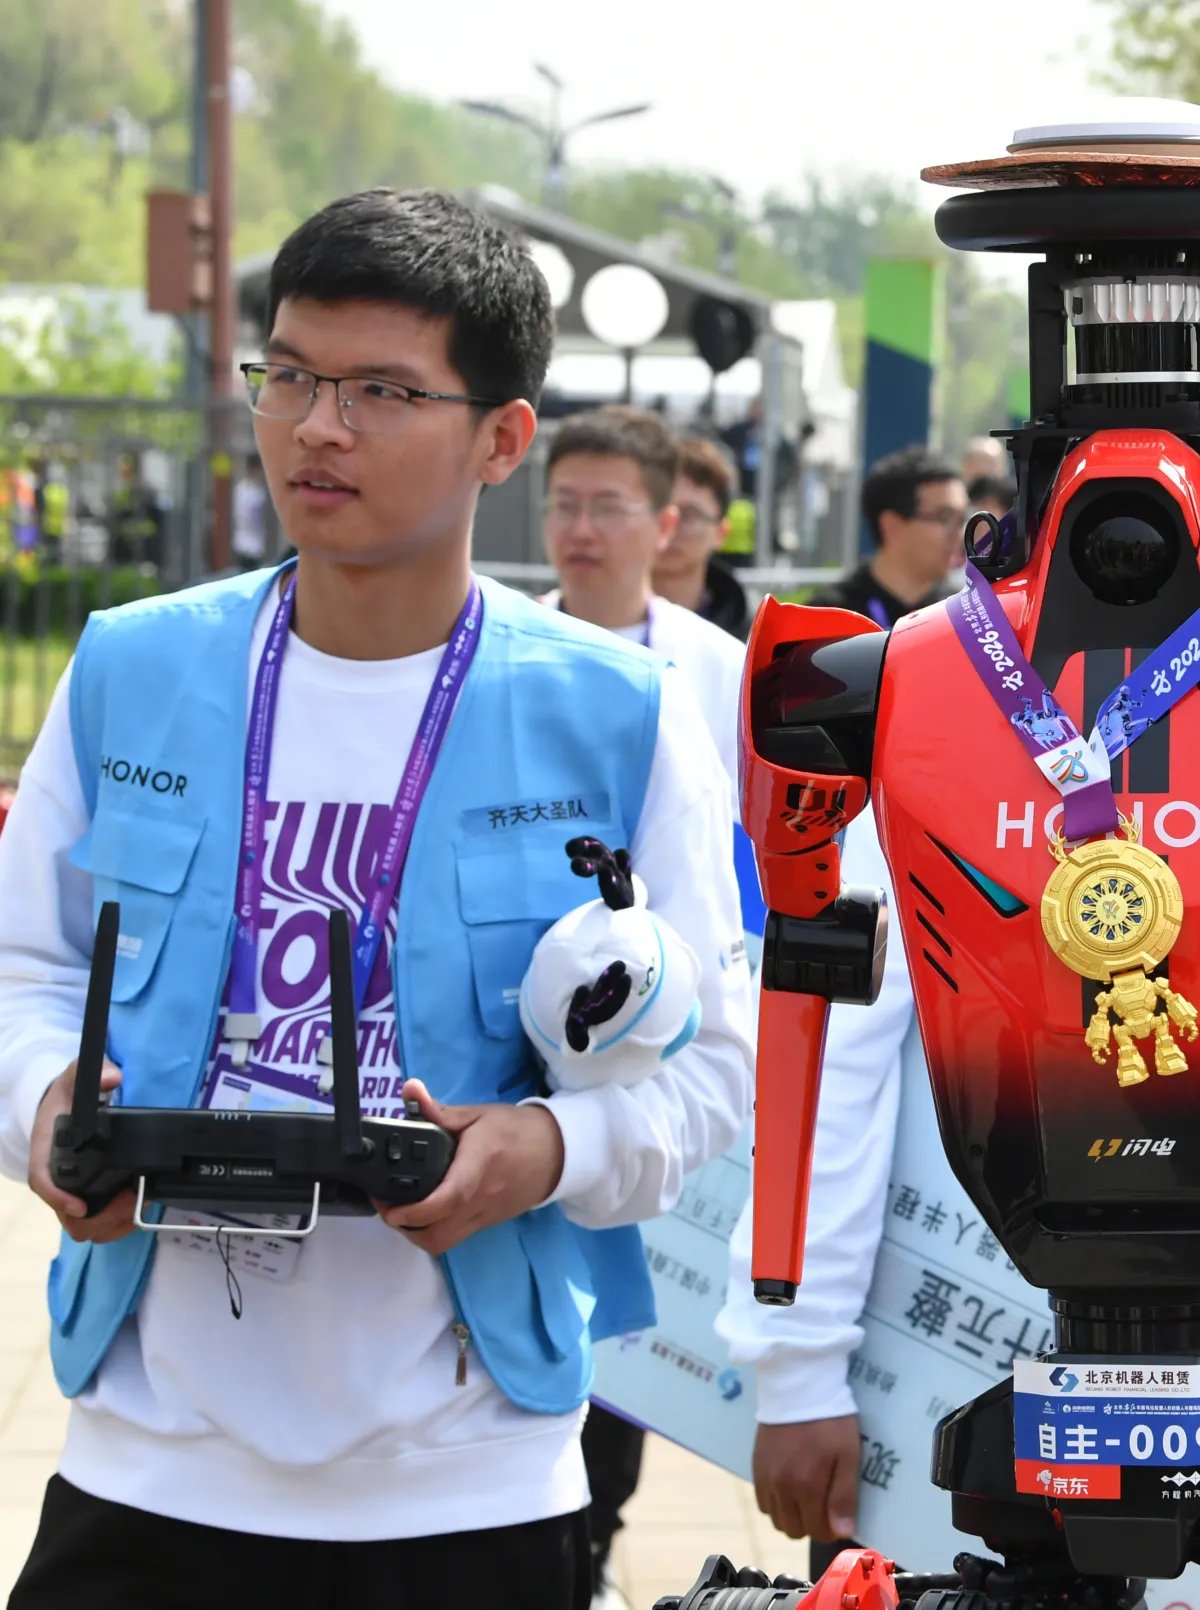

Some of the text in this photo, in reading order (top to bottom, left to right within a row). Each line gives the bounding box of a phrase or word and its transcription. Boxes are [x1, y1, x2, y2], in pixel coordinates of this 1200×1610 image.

[977, 630, 1015, 672] 2026
[101, 755, 188, 797] HONOR
[488, 799, 588, 829] 齐天大圣队
[1121, 1138, 1176, 1156] 闪电
[1085, 1370, 1190, 1385] 北京机器人租赁
[1053, 1477, 1089, 1495] 京东
